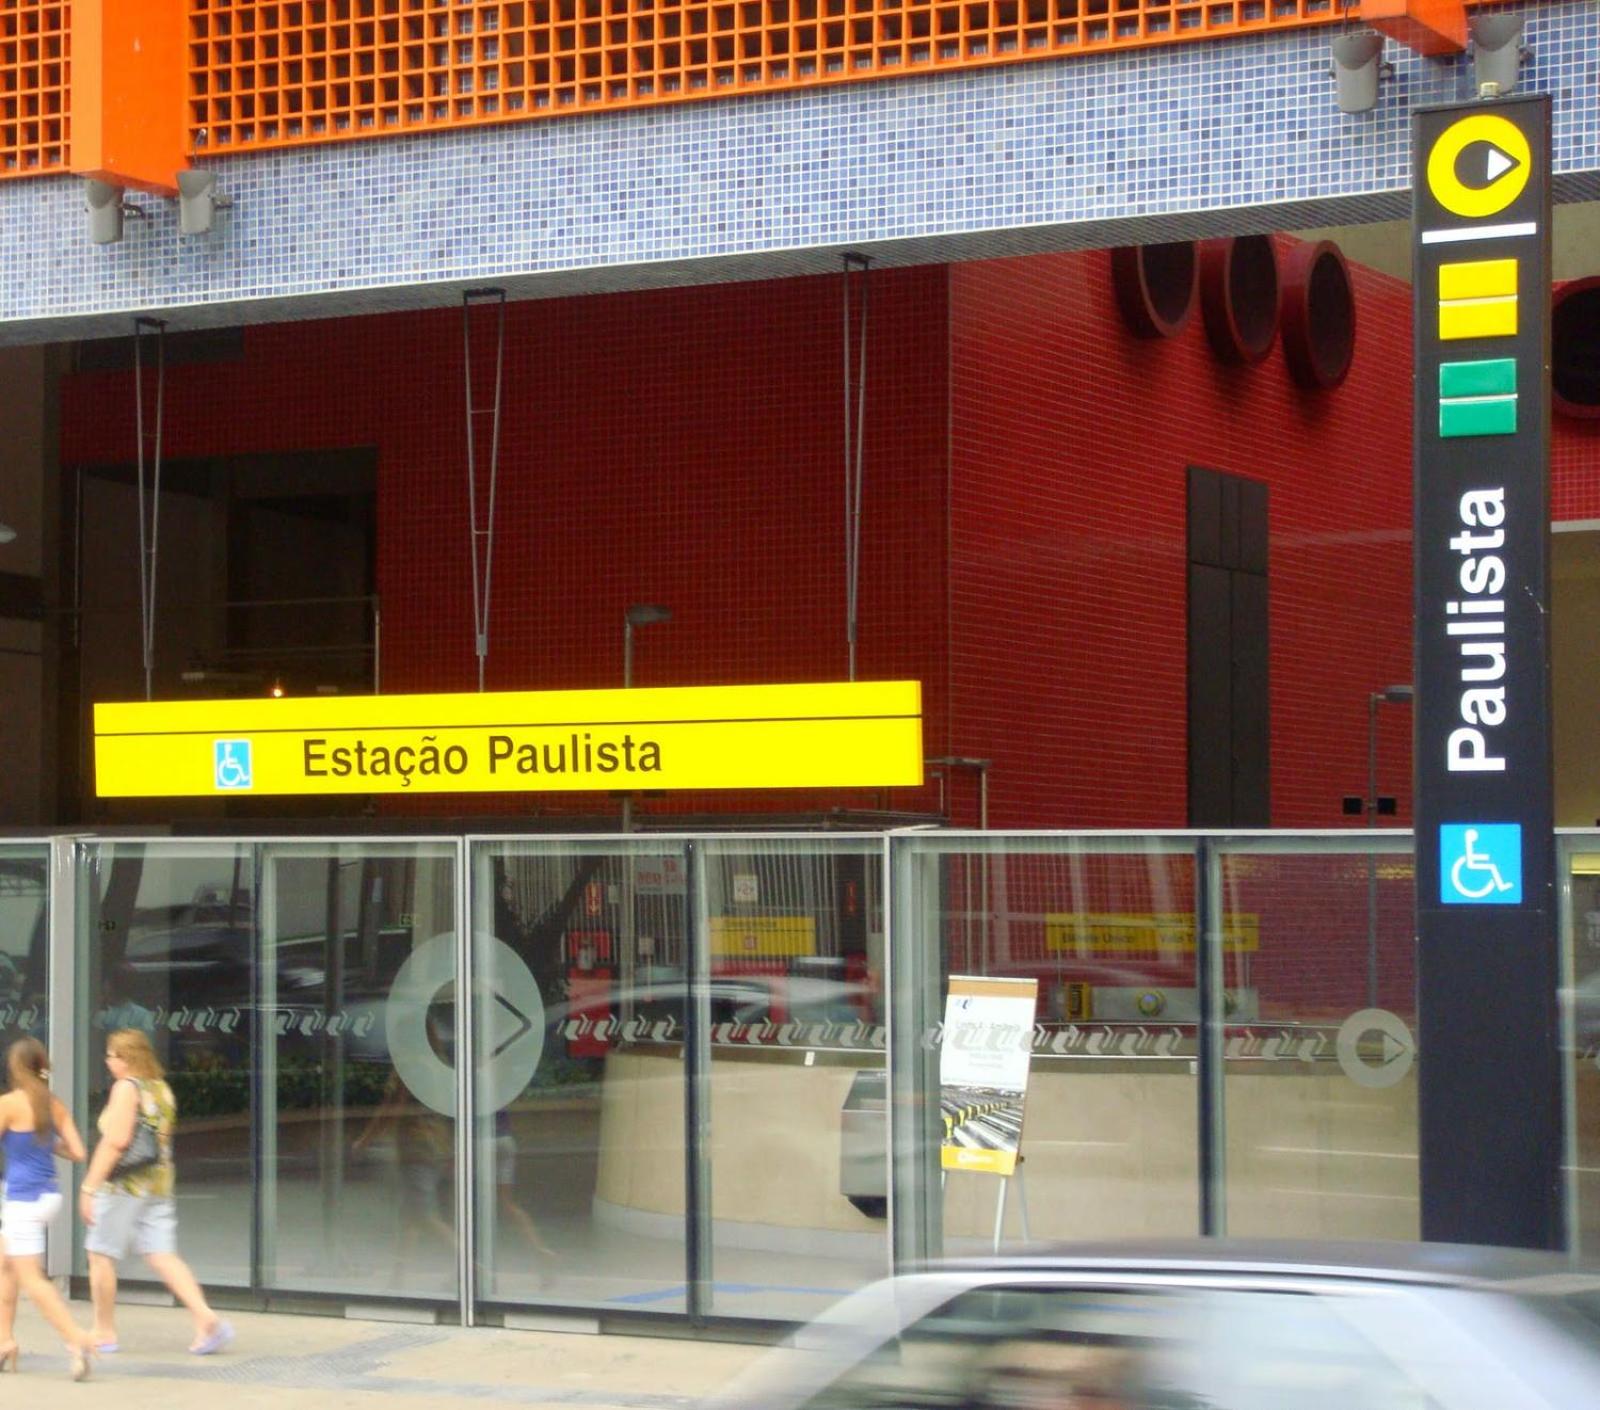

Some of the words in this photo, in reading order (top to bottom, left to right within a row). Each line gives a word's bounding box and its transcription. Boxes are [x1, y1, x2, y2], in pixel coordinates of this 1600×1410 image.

[1446, 487, 1506, 771] Paulista
[303, 735, 468, 787] Estação
[489, 733, 661, 774] Paulista
